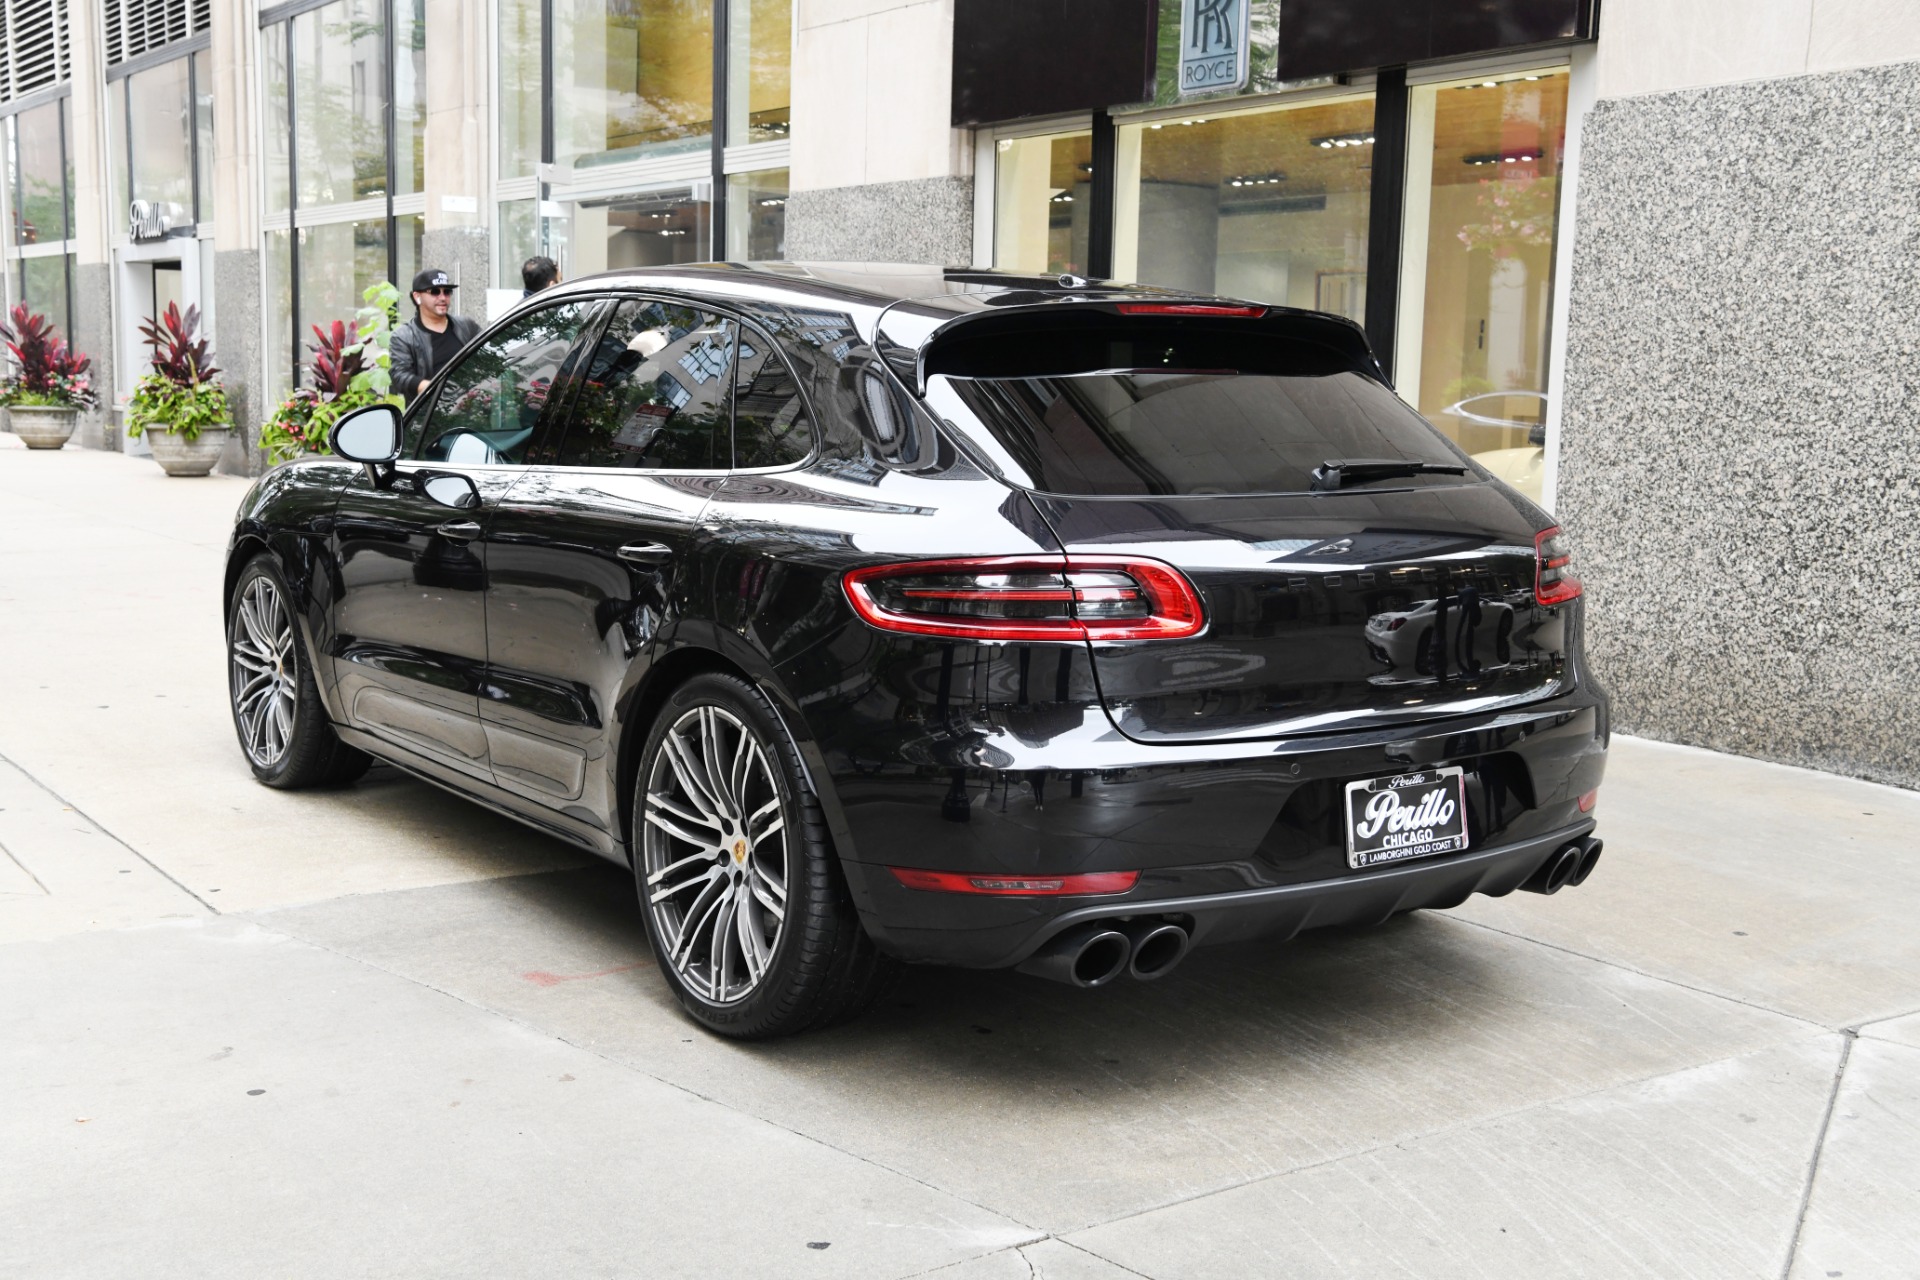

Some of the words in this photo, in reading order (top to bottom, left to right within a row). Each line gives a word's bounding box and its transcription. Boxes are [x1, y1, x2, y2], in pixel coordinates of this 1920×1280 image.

[1185, 59, 1234, 84] ROYCE
[130, 199, 168, 240] Perillo
[1388, 773, 1426, 790] Perillo
[1356, 788, 1455, 839] Perillo
[1382, 828, 1433, 848] CHICAGO
[1369, 846, 1413, 862] LAMBORGHINI
[1414, 842, 1431, 855] GOLD
[1432, 840, 1451, 852] COAST
